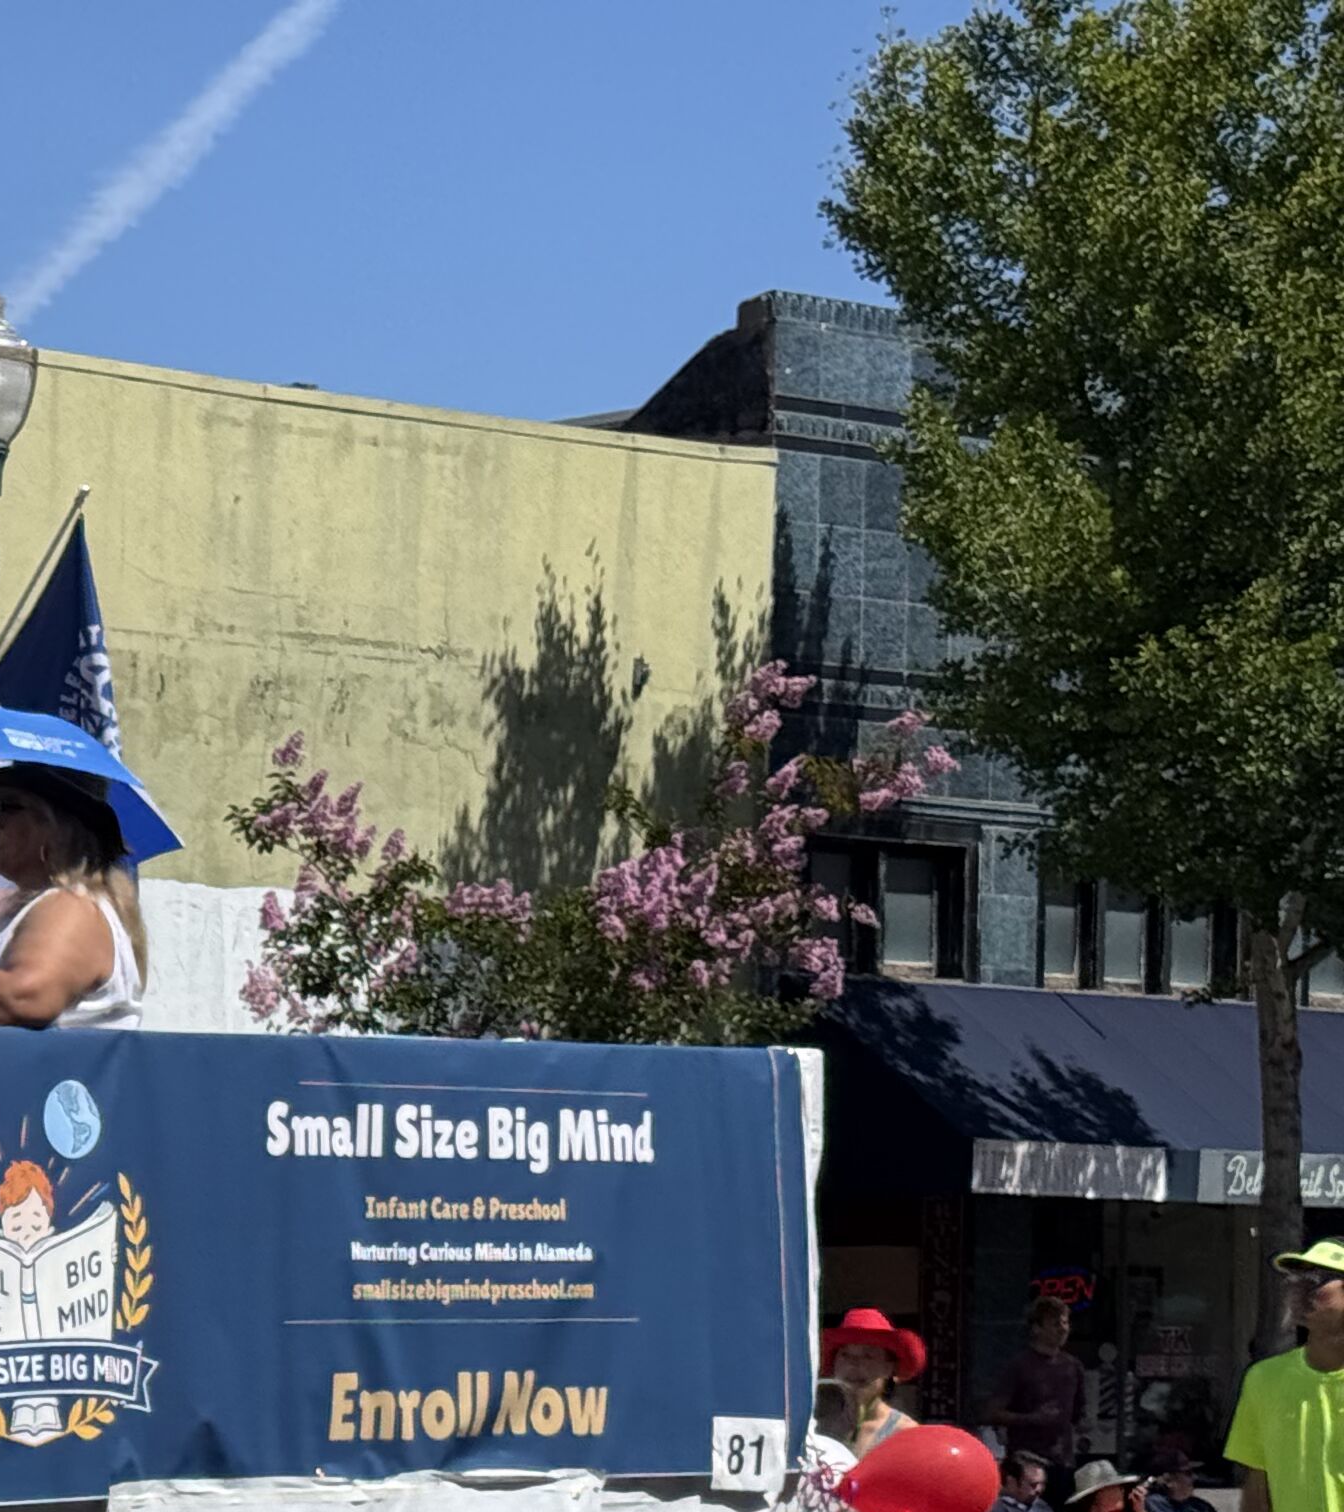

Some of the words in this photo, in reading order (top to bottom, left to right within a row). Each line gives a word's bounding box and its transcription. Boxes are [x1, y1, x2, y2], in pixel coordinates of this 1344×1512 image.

[266, 1101, 384, 1158] Small
[395, 1104, 479, 1159] Size
[488, 1107, 550, 1173] Big
[559, 1108, 655, 1163] Mind
[365, 1196, 427, 1220] Infant
[431, 1197, 469, 1220] Care
[473, 1197, 485, 1220] &
[489, 1198, 567, 1221] Preschool
[65, 1250, 102, 1289] BIG
[351, 1241, 417, 1265] Nurturing
[420, 1242, 472, 1261] Curious
[475, 1242, 517, 1261] Minds
[519, 1243, 532, 1261] in
[534, 1242, 593, 1261] Alameda
[57, 1289, 109, 1333] MIND
[352, 1279, 594, 1305] smallsizebigmindpreschool.com
[50, 1353, 87, 1381] BIG
[328, 1371, 490, 1441] Enroll
[493, 1370, 608, 1436] Now
[727, 1433, 766, 1477] 81
